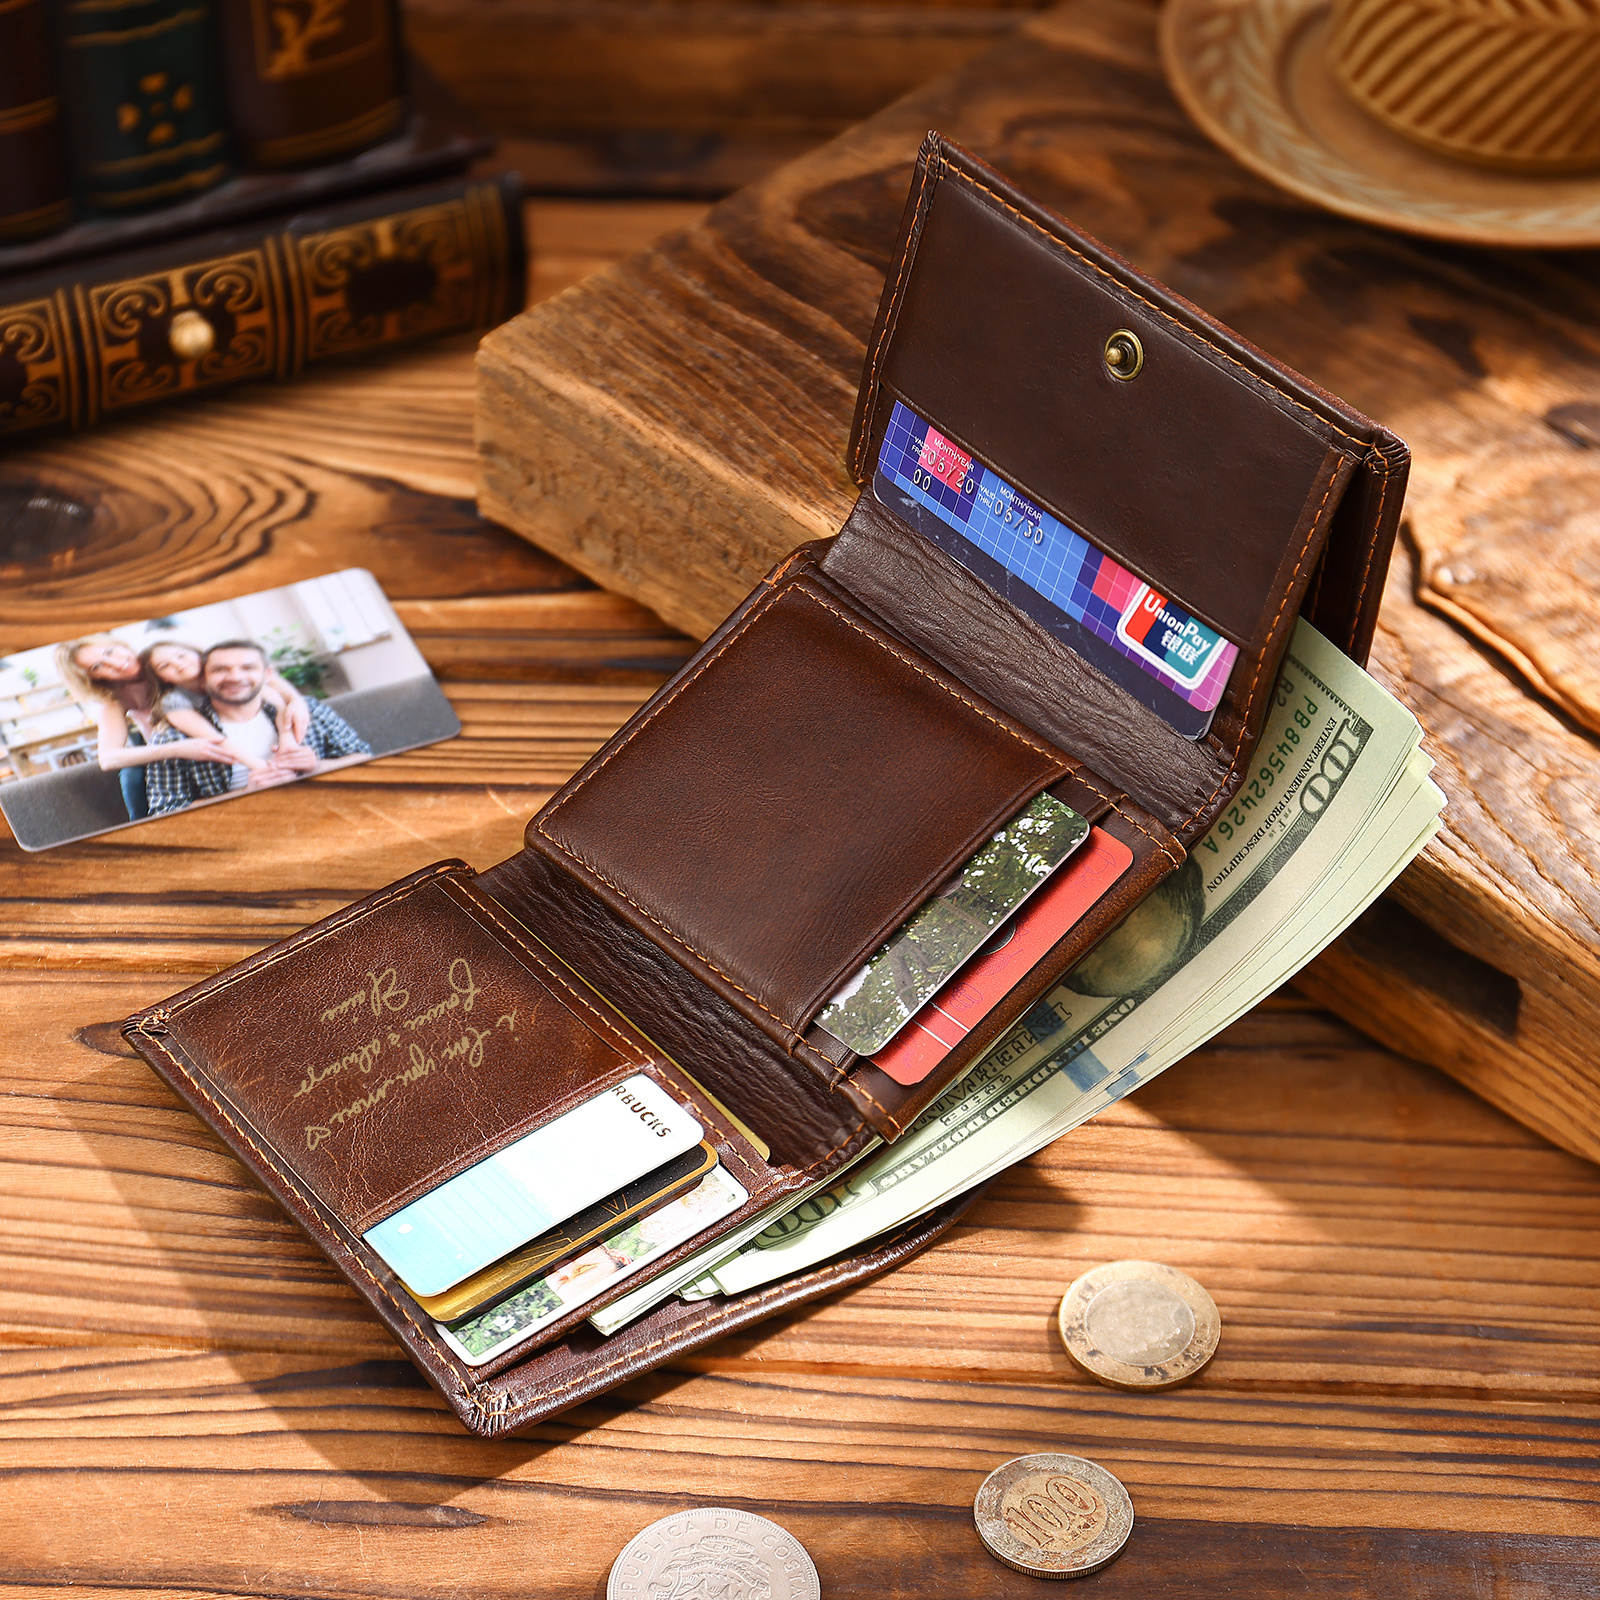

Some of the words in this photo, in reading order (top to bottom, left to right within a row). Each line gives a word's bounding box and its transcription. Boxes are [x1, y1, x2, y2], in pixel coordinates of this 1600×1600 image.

[911, 444, 927, 460] FROM
[914, 436, 930, 451] VALID
[934, 437, 975, 473] MONTH/YEAR
[977, 494, 993, 508] THRU
[979, 485, 996, 500] VALID
[1000, 486, 1043, 521] MONTH/YEAR
[1143, 593, 1212, 655] UnionPay
[1160, 629, 1200, 666] 银联
[1283, 716, 1338, 803] ENTERTAINMENT
[1299, 718, 1363, 815] 100
[1264, 801, 1286, 830] PROP
[1206, 827, 1267, 893] DESCRIPTION
[1091, 998, 1137, 1037] ONE
[611, 1085, 672, 1137] RBUCKS
[879, 1114, 988, 1190] DOLLARS
[714, 1517, 752, 1536] DE
[1006, 1476, 1098, 1548] 100
